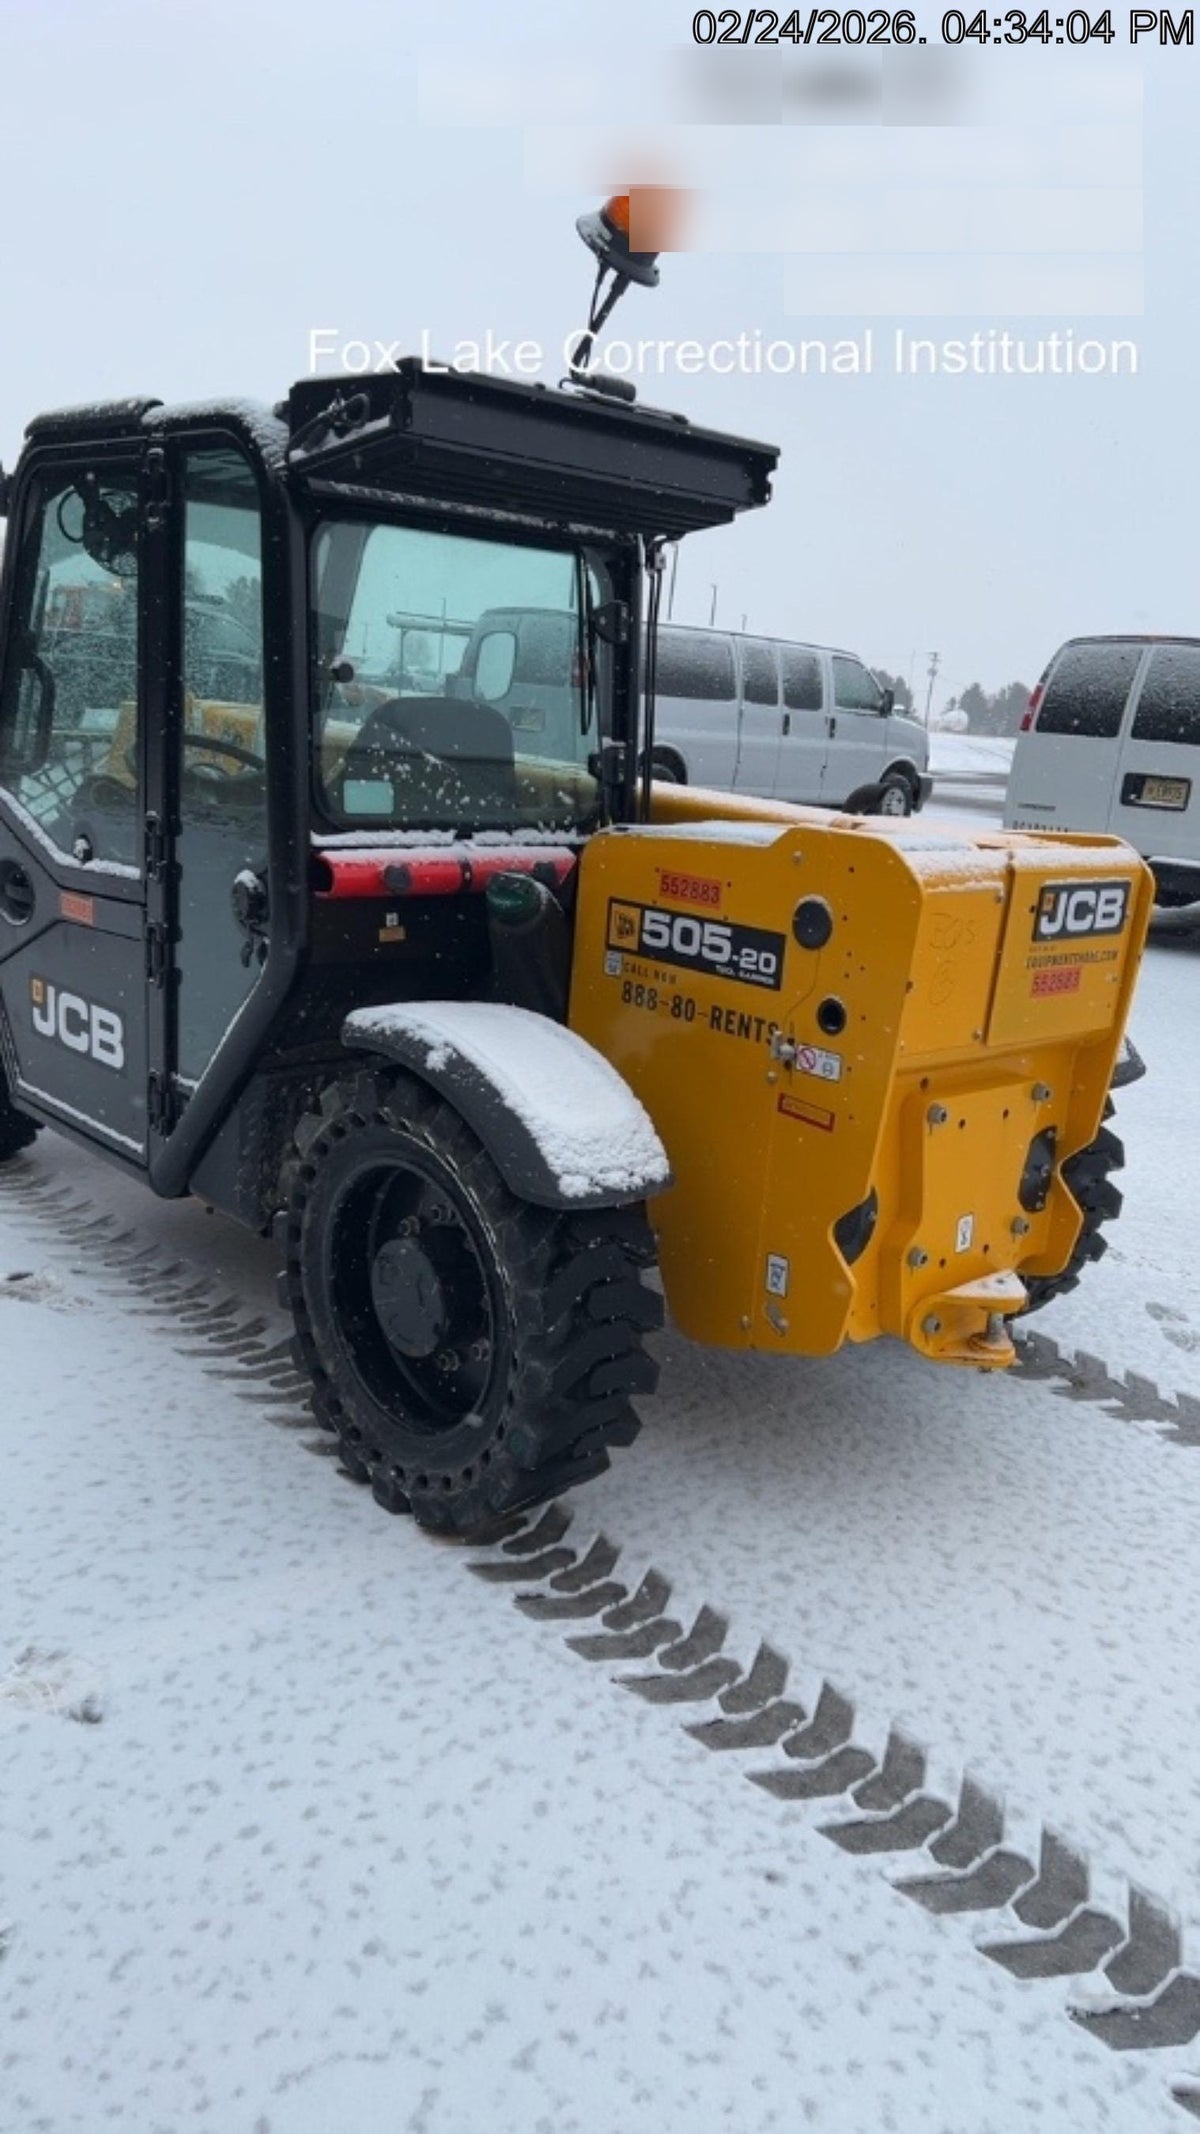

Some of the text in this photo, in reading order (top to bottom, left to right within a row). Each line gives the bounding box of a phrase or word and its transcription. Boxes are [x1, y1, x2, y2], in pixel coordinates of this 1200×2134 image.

[660, 873, 720, 905] 552883
[1040, 888, 1125, 936] JCB
[32, 985, 124, 1070] JCB
